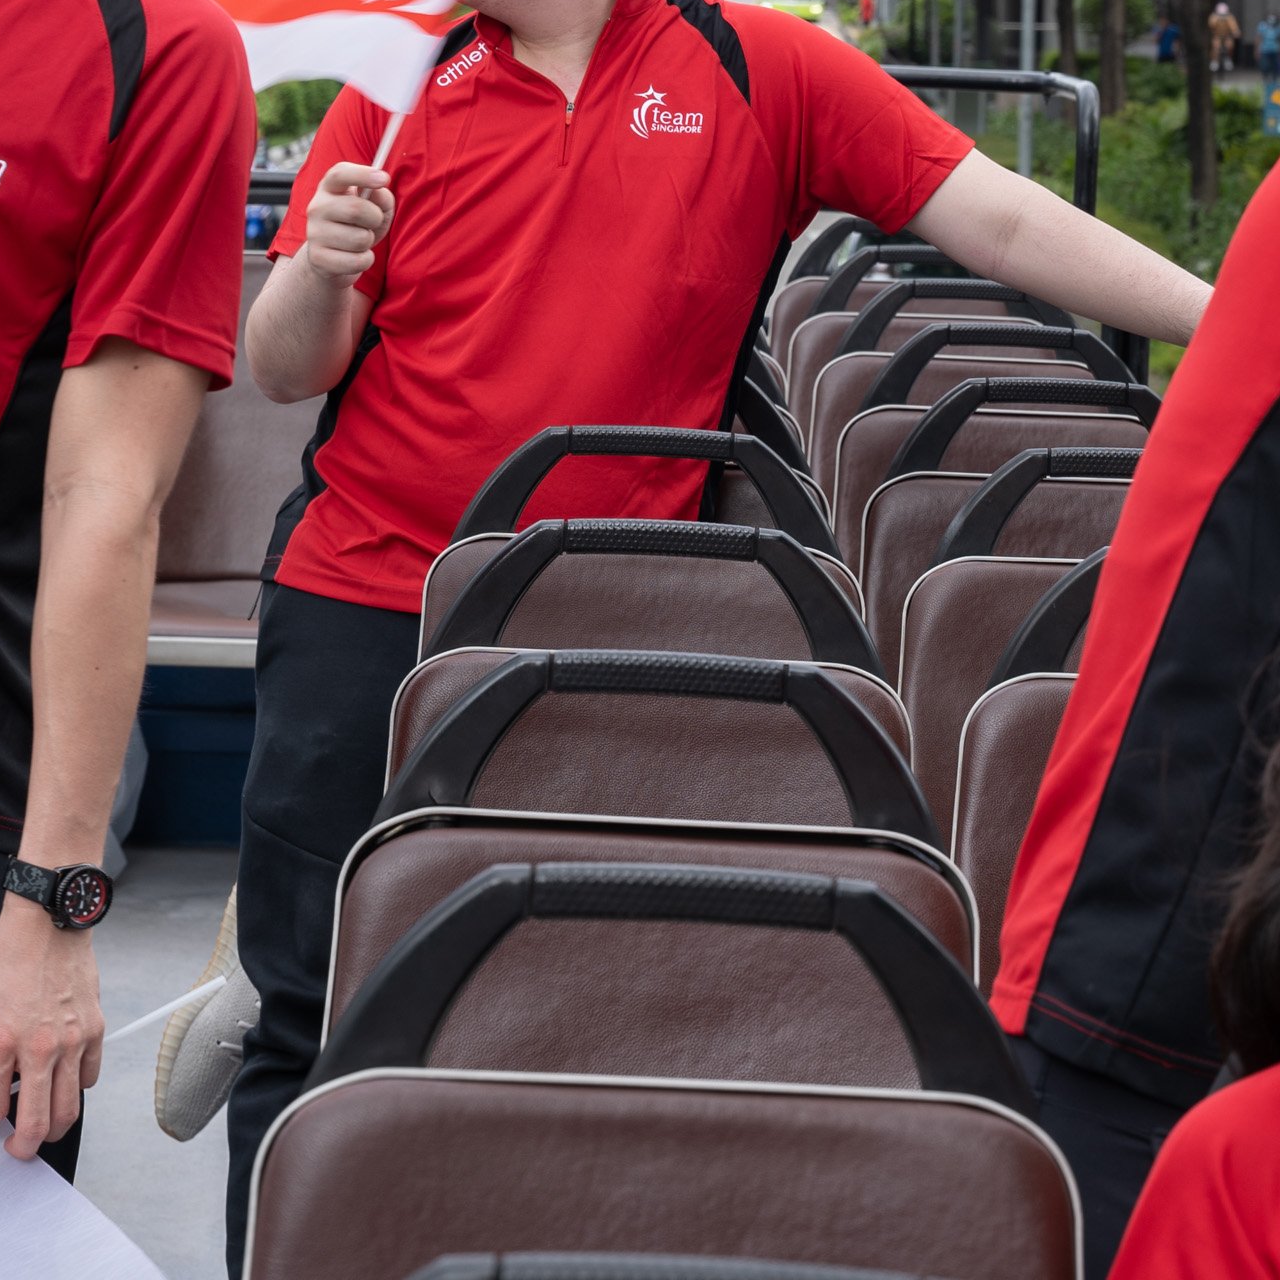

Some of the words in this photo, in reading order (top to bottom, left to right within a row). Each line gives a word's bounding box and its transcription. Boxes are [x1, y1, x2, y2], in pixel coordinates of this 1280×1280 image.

[436, 41, 489, 87] athlet
[652, 107, 704, 126] team
[651, 123, 702, 134] SINGAPORE
